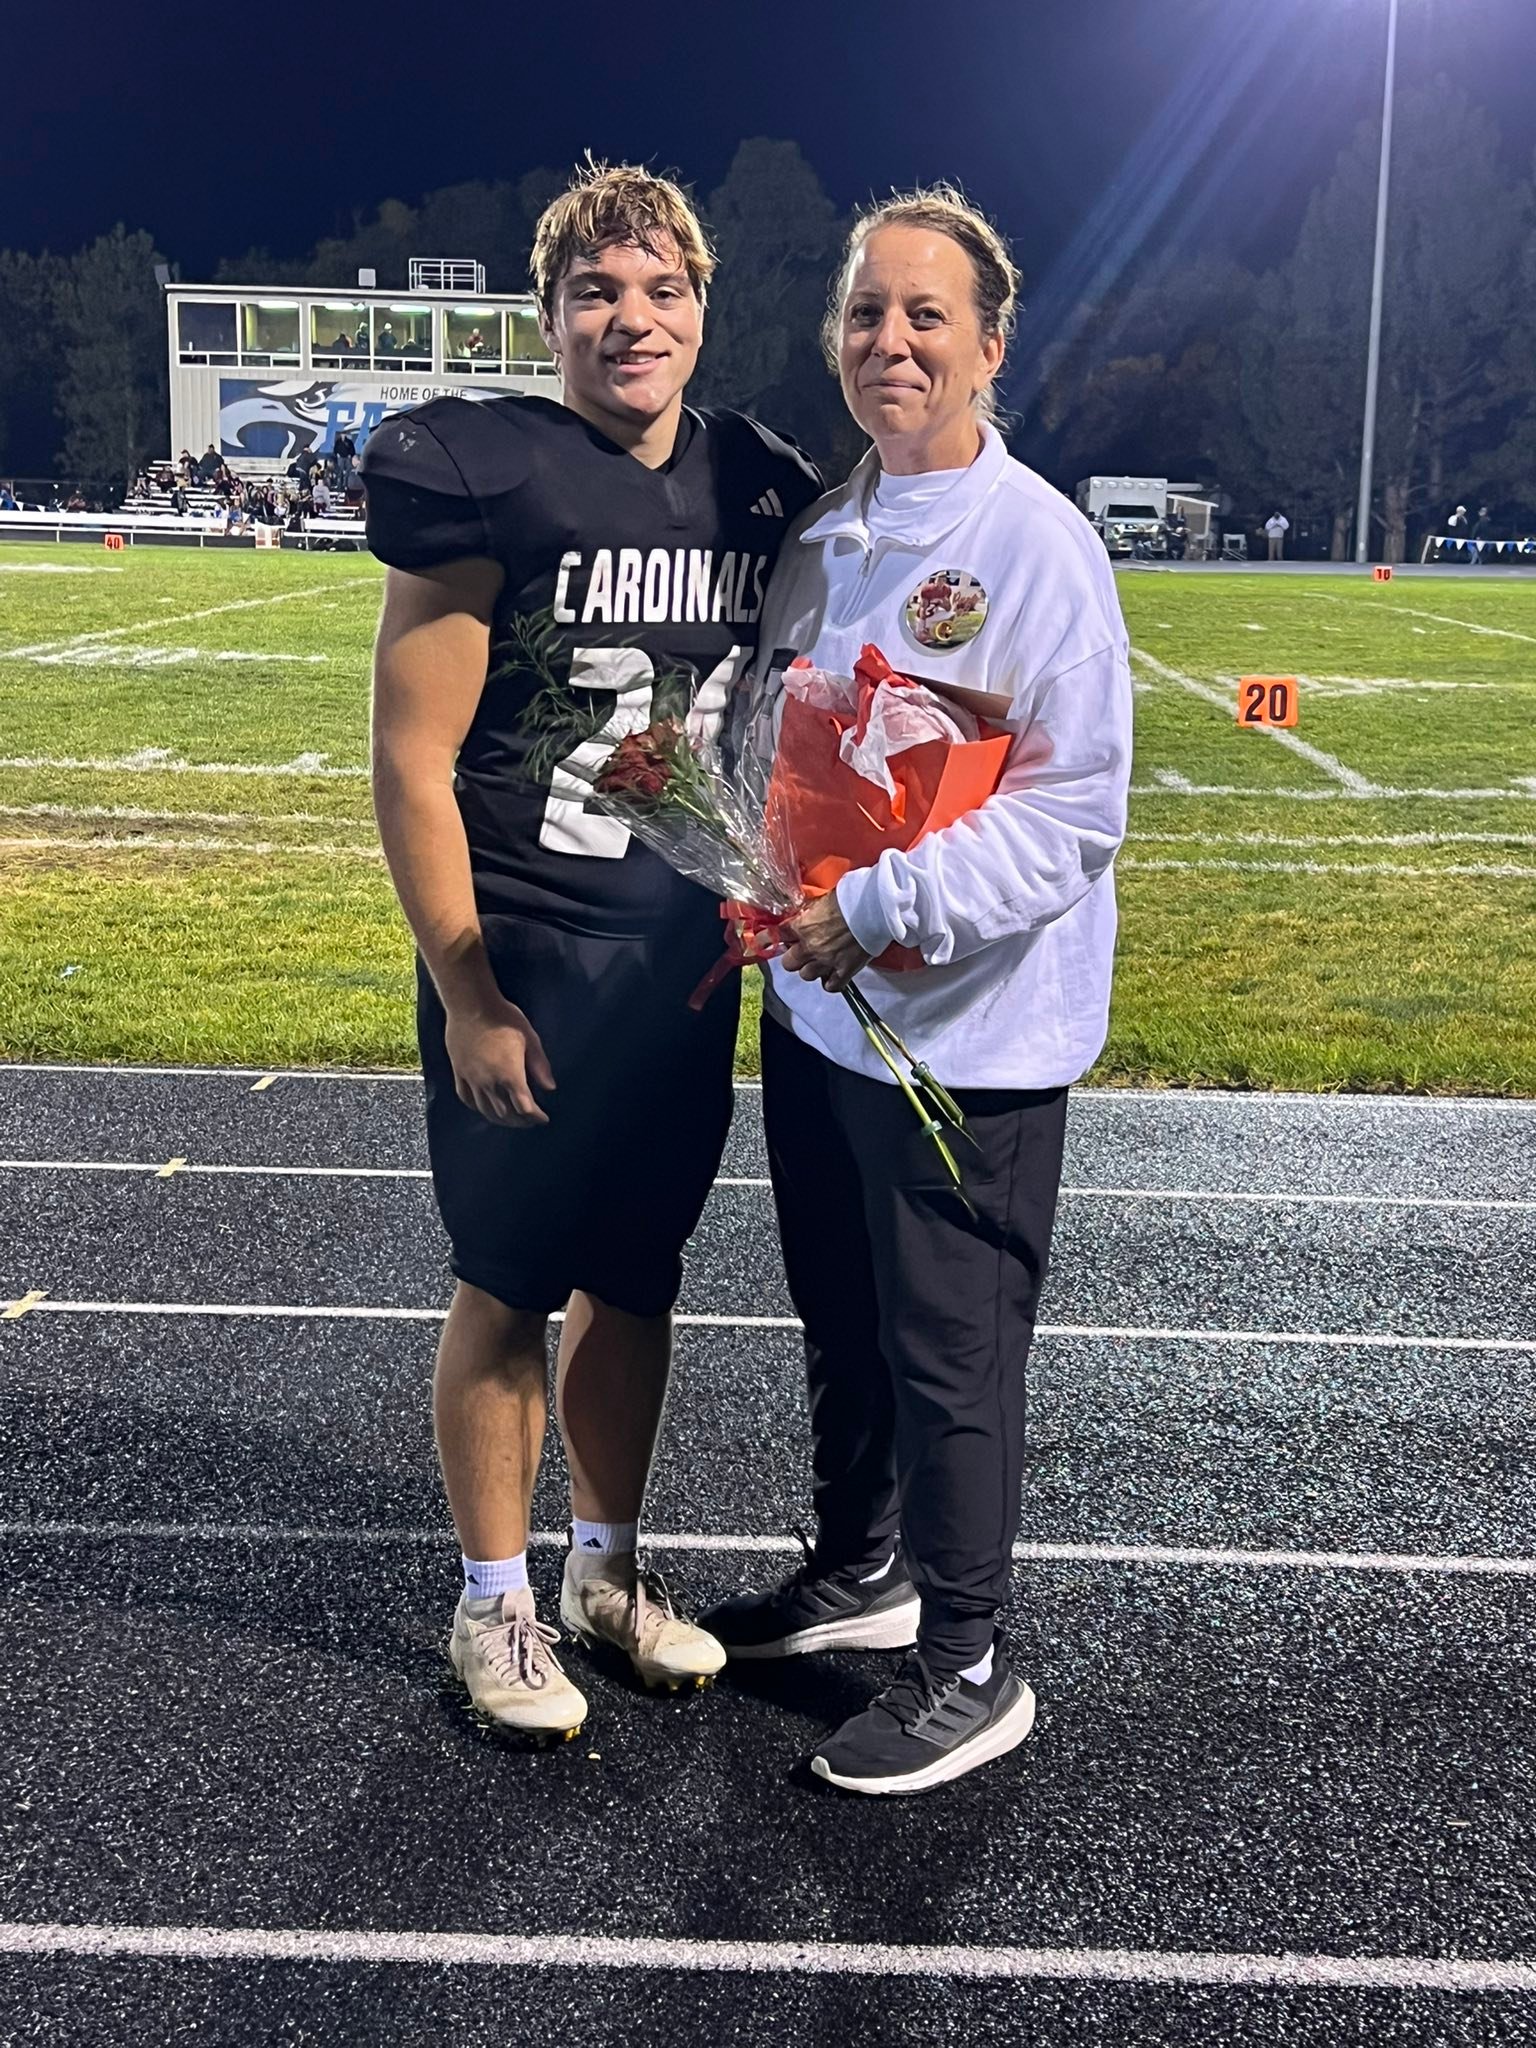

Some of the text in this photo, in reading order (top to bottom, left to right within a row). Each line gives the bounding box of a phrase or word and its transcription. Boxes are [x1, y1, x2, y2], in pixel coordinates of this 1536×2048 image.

[380, 386, 419, 401] HOME
[421, 387, 440, 401] OF
[106, 536, 120, 549] 40
[1376, 568, 1391, 581] 10
[553, 548, 768, 624] CARDINALS
[1244, 683, 1288, 722] 20
